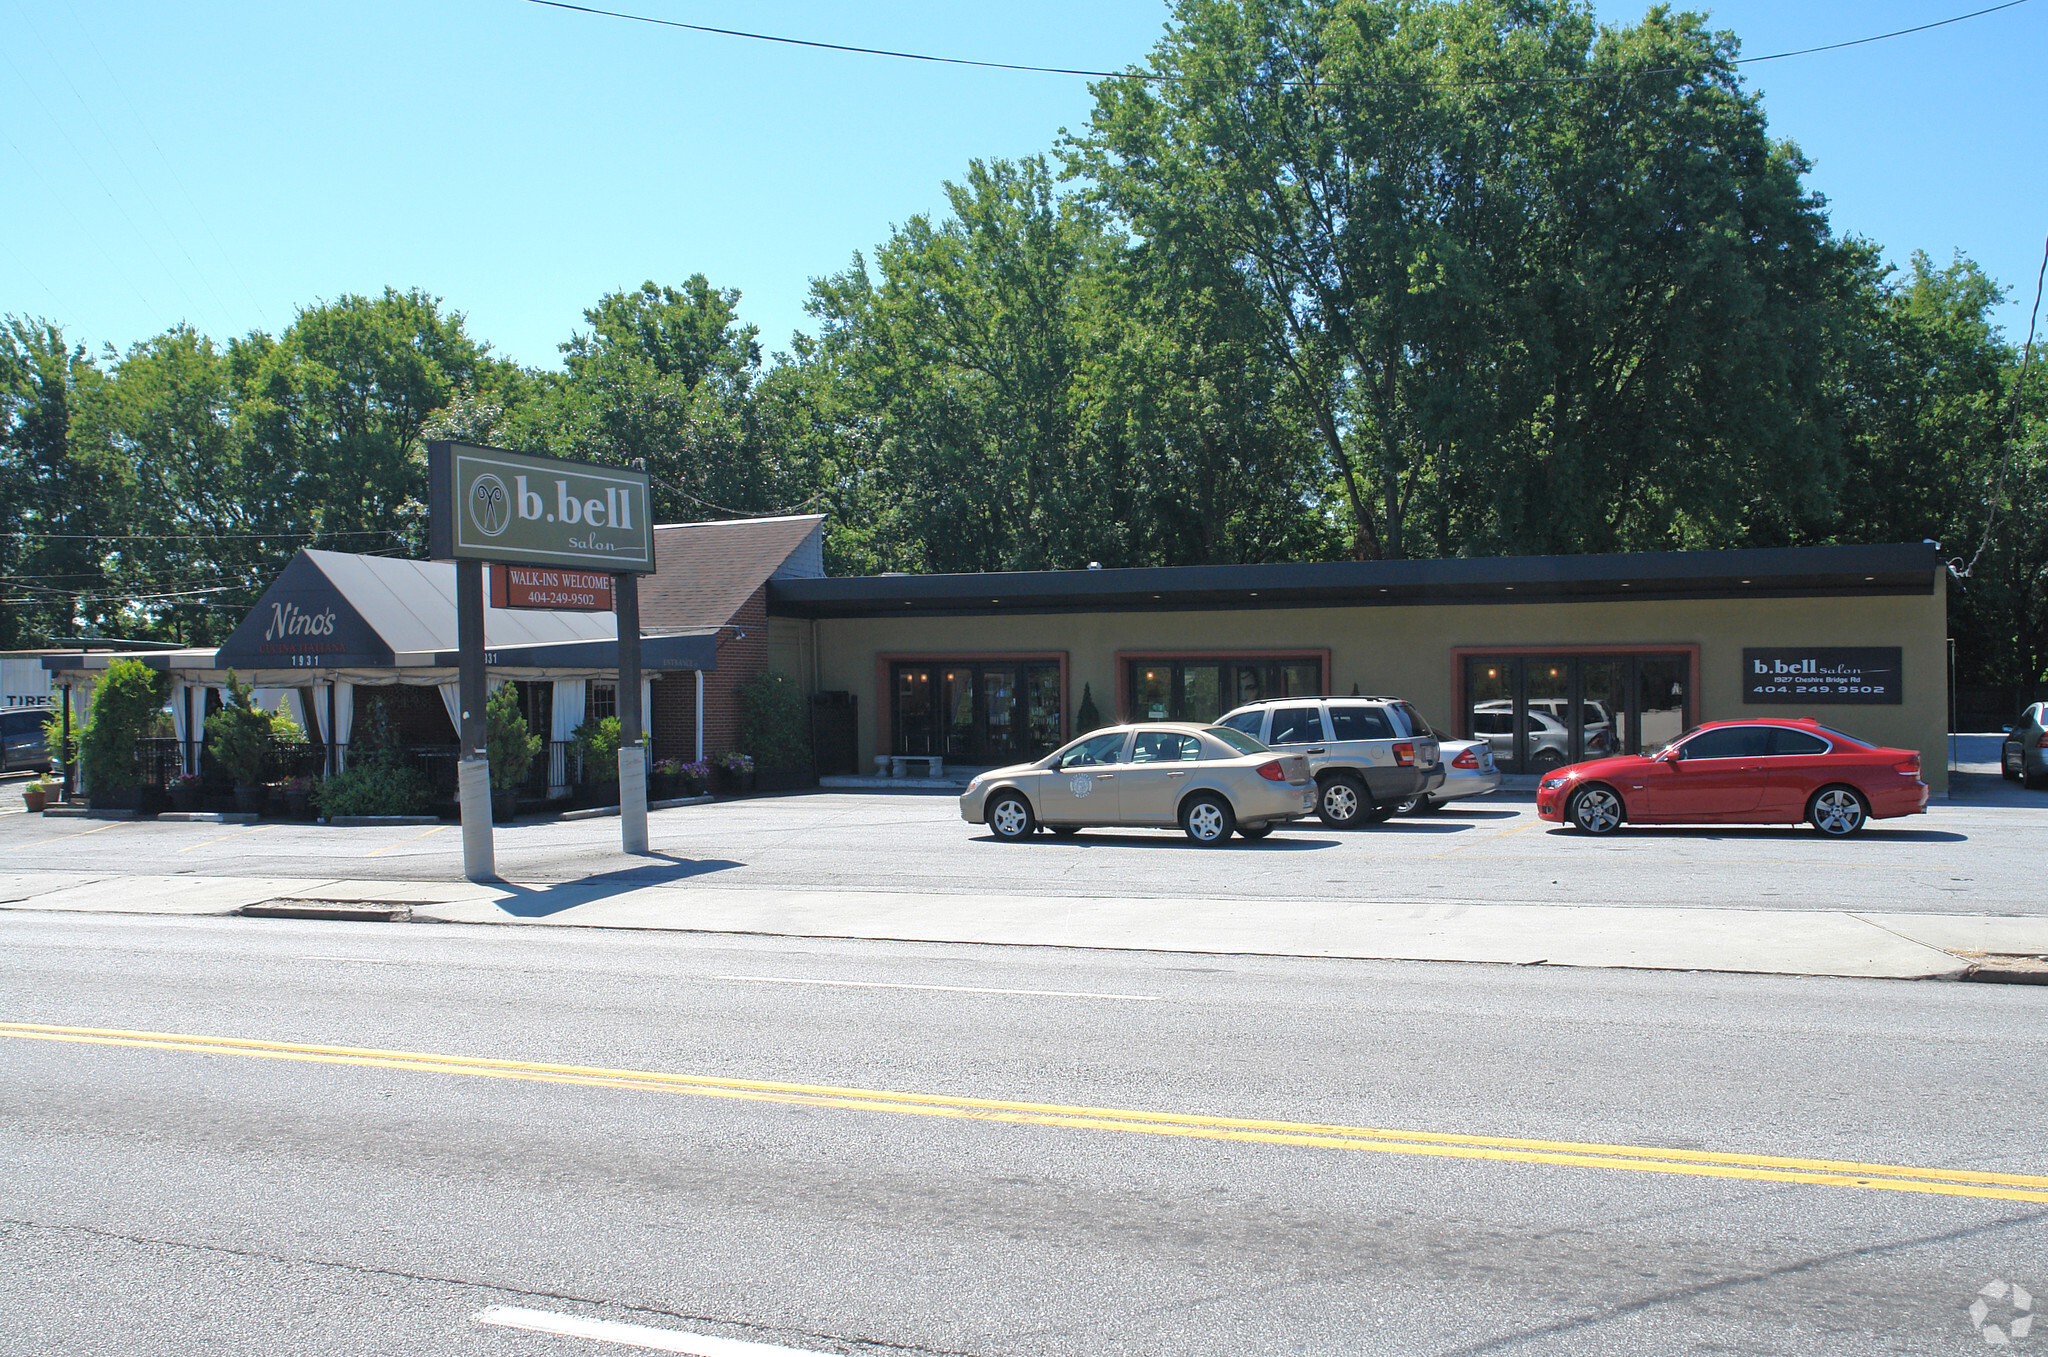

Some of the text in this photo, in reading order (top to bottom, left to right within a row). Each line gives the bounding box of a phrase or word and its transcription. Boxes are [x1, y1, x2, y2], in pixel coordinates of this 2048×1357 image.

[513, 475, 634, 530] b.bell
[510, 570, 610, 590] WALK-INS WELCOME
[528, 591, 595, 605] 404-249-9502
[265, 602, 336, 641] Nino's
[291, 655, 319, 667] 1931
[1753, 659, 1817, 674] b.bell
[1825, 676, 1849, 684] Bridge
[1838, 686, 1885, 694] 9502
